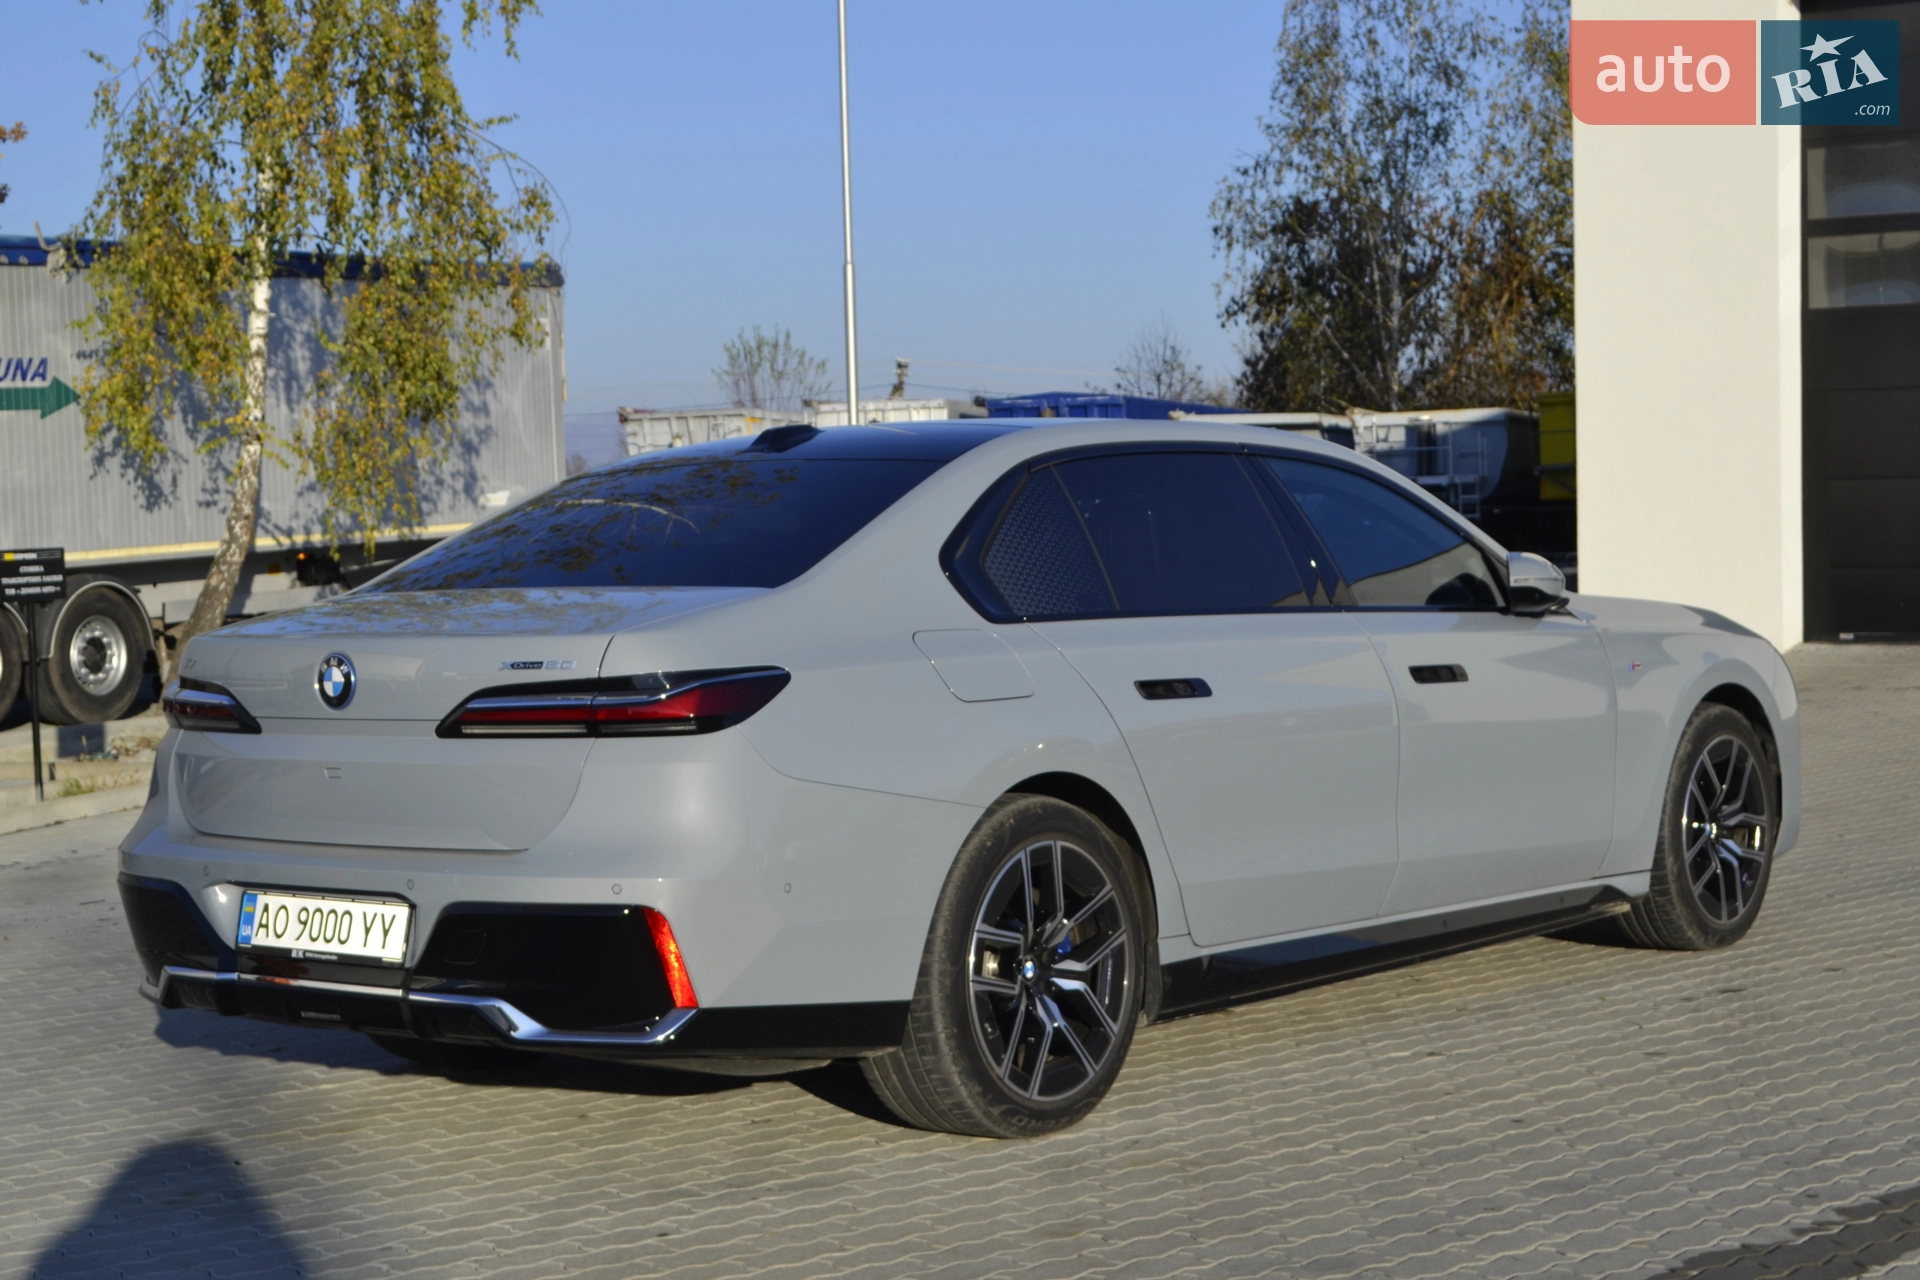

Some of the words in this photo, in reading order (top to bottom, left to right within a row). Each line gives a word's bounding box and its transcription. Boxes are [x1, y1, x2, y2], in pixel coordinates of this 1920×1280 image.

[241, 924, 252, 936] UA
[255, 902, 289, 939] AO
[295, 906, 353, 945] 9000
[362, 911, 397, 949] YY
